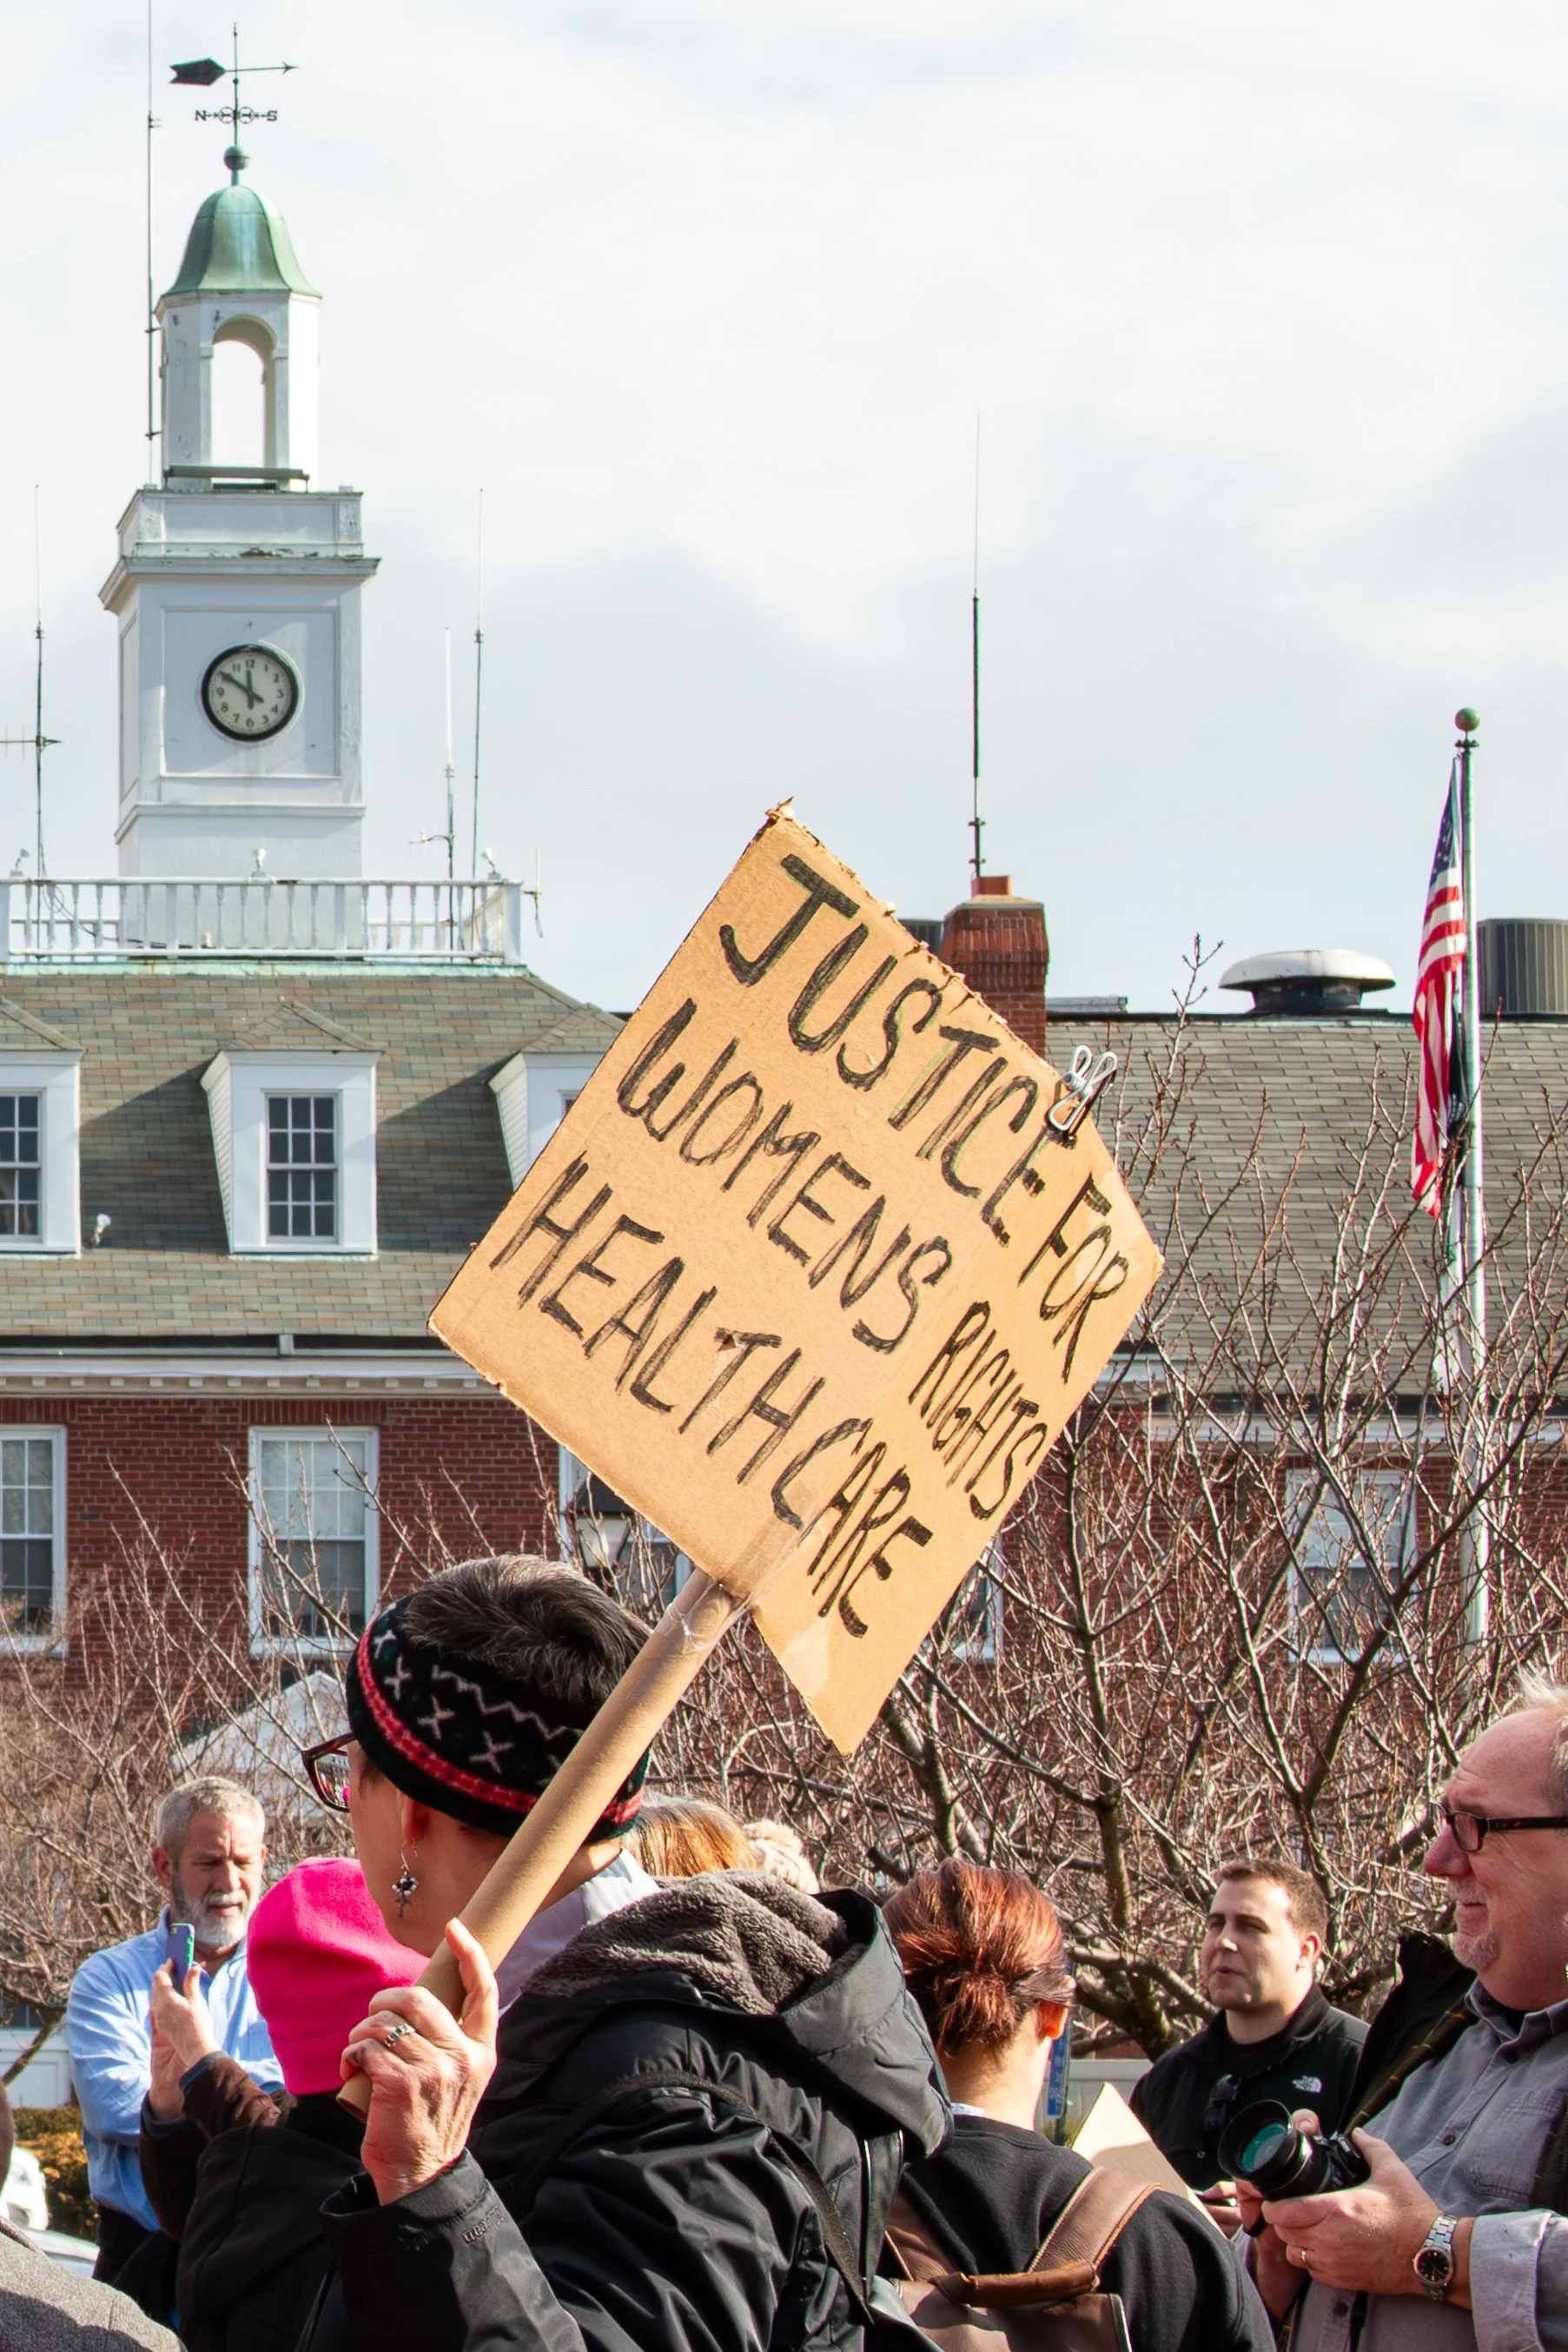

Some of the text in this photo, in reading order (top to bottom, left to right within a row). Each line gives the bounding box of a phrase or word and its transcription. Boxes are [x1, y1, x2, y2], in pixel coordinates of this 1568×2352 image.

[195, 110, 207, 121] N
[267, 110, 278, 122] S
[232, 713, 241, 724] 7
[719, 853, 1129, 1383] JUSTICE FOR
[617, 997, 1048, 1521] WOMENS RIGHTS
